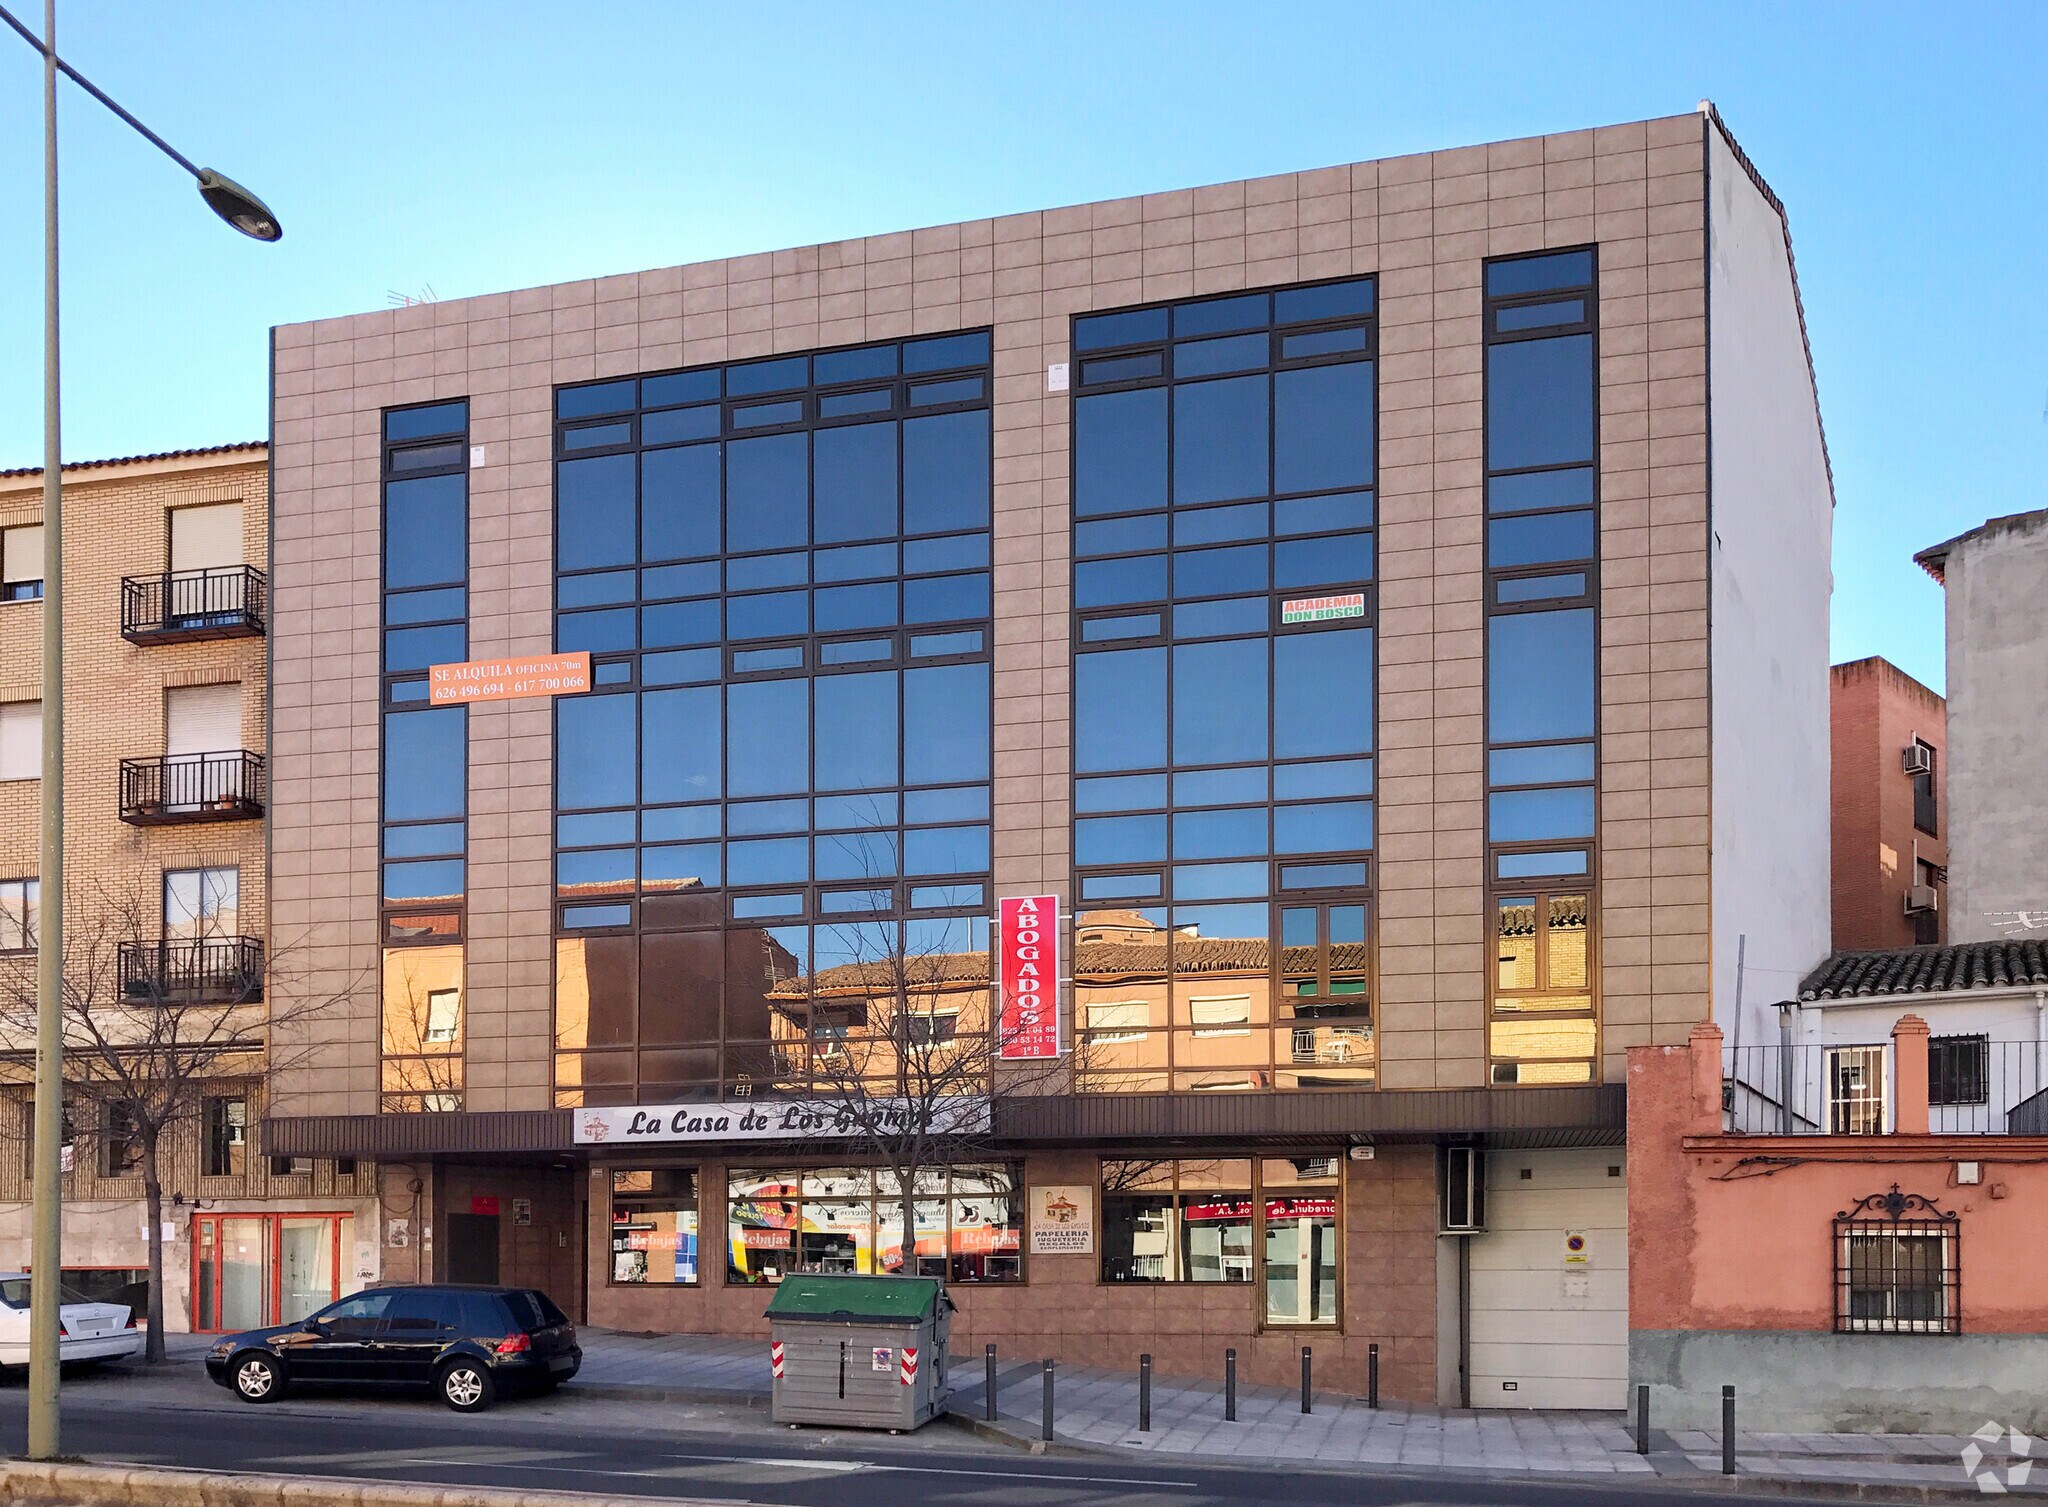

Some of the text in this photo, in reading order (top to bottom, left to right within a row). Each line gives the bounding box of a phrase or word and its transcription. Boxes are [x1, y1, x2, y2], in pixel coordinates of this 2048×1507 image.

[1284, 595, 1362, 612] ACADEMIA
[1284, 606, 1362, 622] DON BOSCO
[434, 669, 450, 681] SE
[453, 664, 512, 680] ALQUILA
[515, 662, 558, 674] OFICINA
[435, 687, 456, 699] 626
[459, 684, 480, 697] 496
[483, 682, 504, 695] 694
[514, 679, 535, 692] 617
[538, 677, 560, 690] 700
[562, 675, 584, 688] 066
[1016, 899, 1040, 1025] ABOGADOS
[1020, 1036, 1030, 1044] 53
[1033, 1035, 1042, 1043] 14
[1033, 1046, 1039, 1054] B
[626, 1111, 661, 1134] La
[671, 1110, 729, 1133] Casa
[739, 1108, 767, 1131] de
[779, 1106, 823, 1129] Los
[738, 1232, 790, 1248] Rebajas
